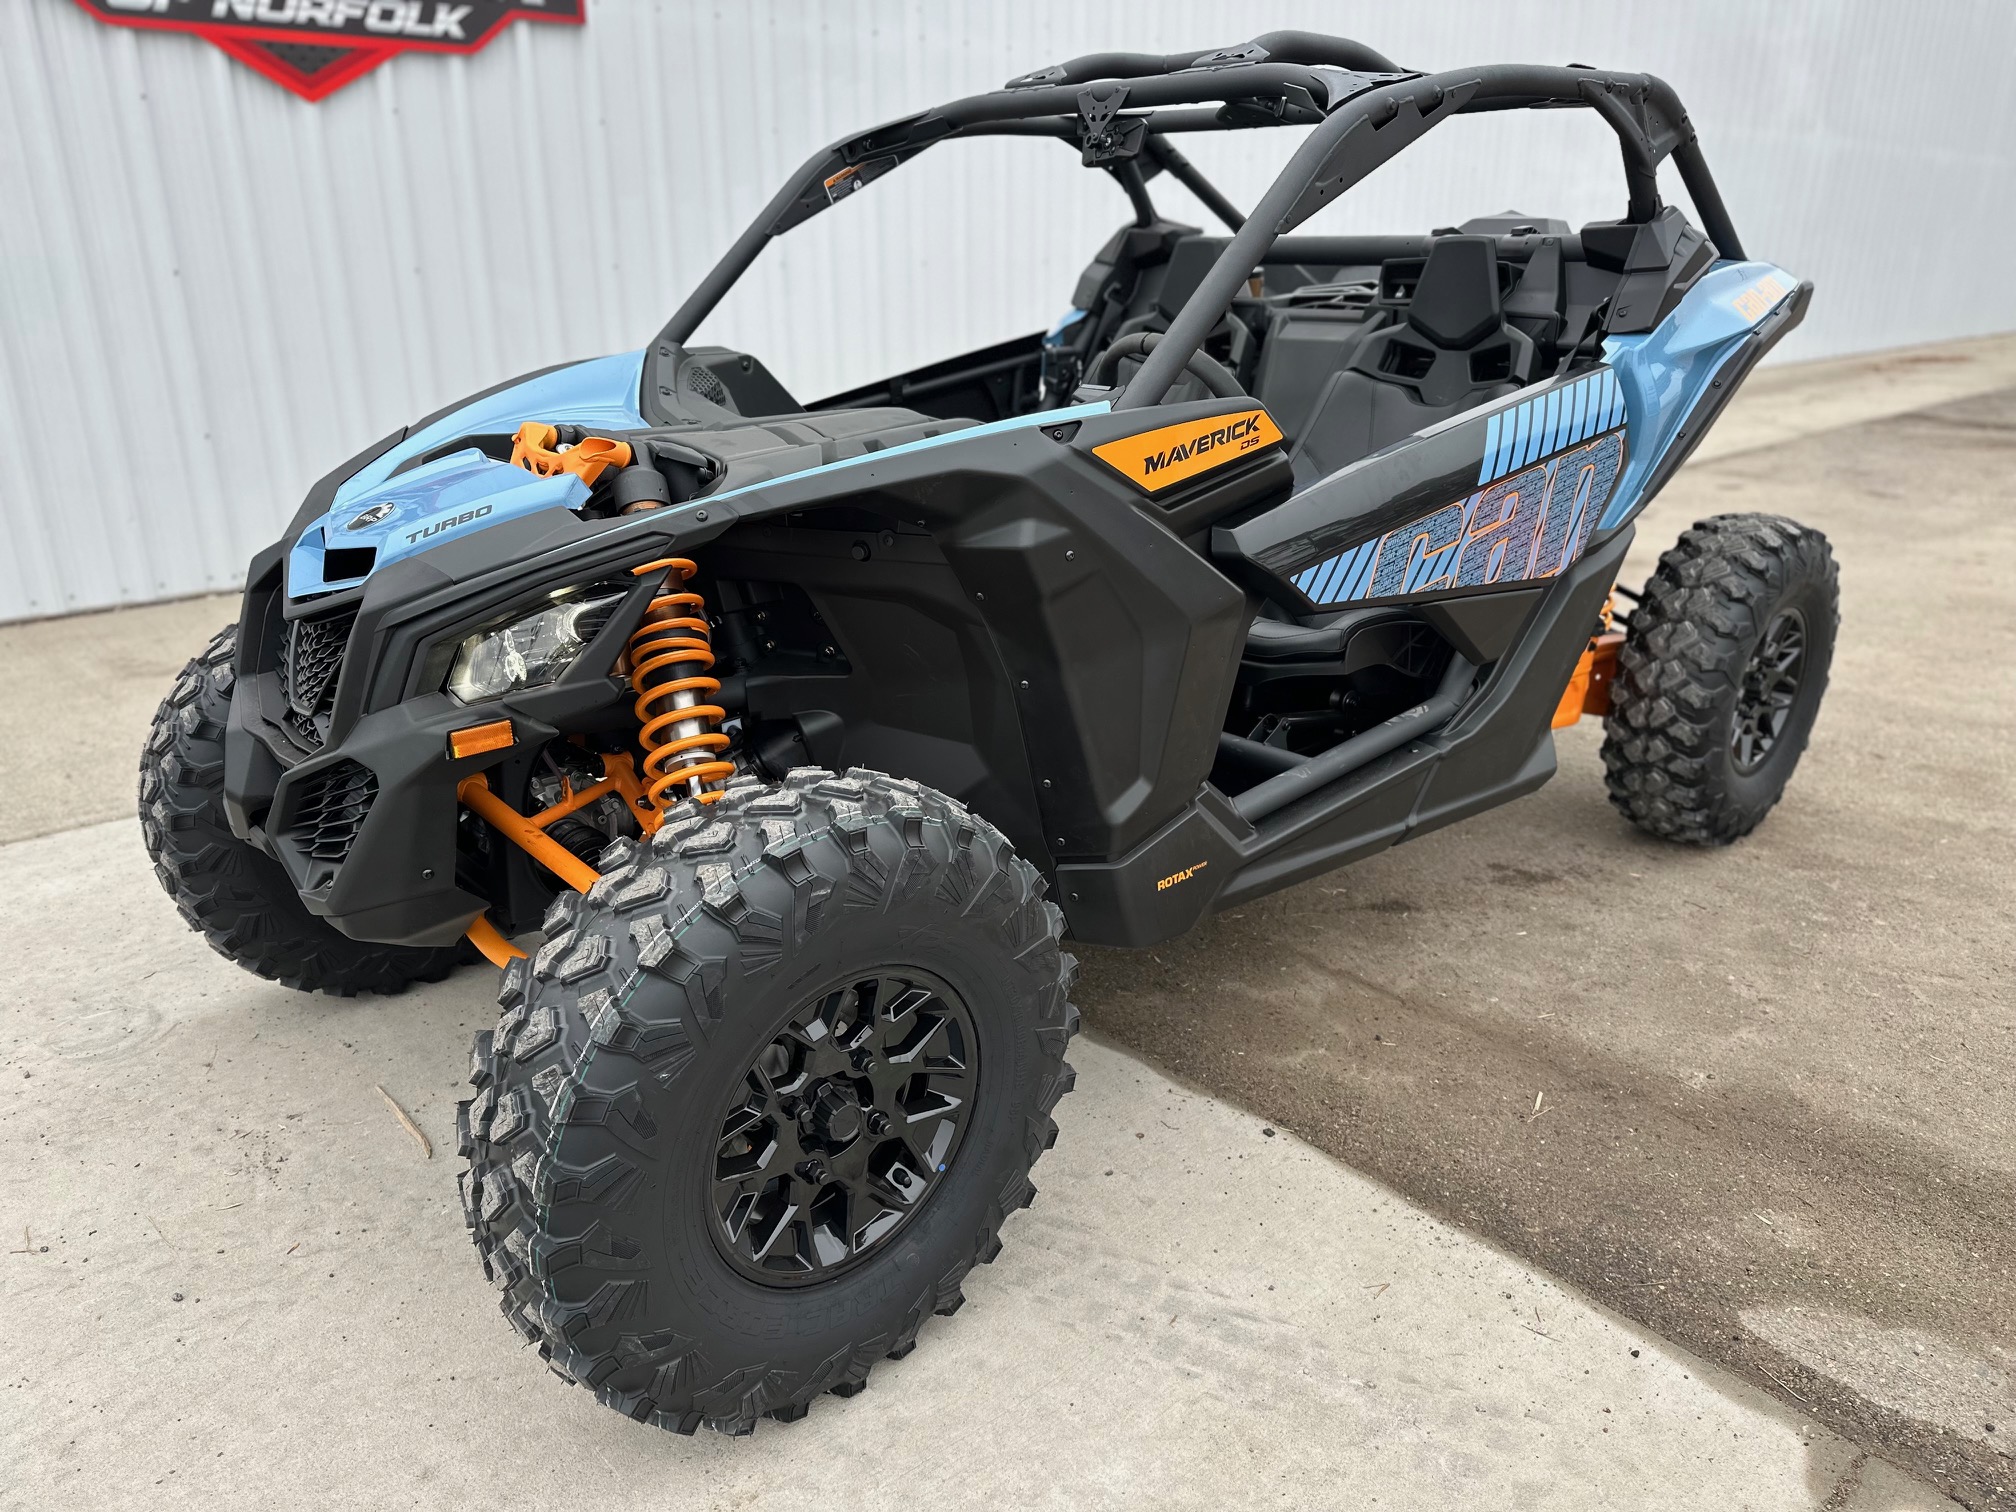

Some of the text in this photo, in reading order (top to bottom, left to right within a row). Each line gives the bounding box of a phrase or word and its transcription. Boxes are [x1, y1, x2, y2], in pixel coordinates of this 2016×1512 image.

[211, 0, 473, 39] NORFOLK
[1144, 414, 1261, 475] MAVERICK
[1240, 435, 1260, 451] DS
[406, 504, 493, 544] TURBO
[1157, 867, 1194, 891] ROTAX
